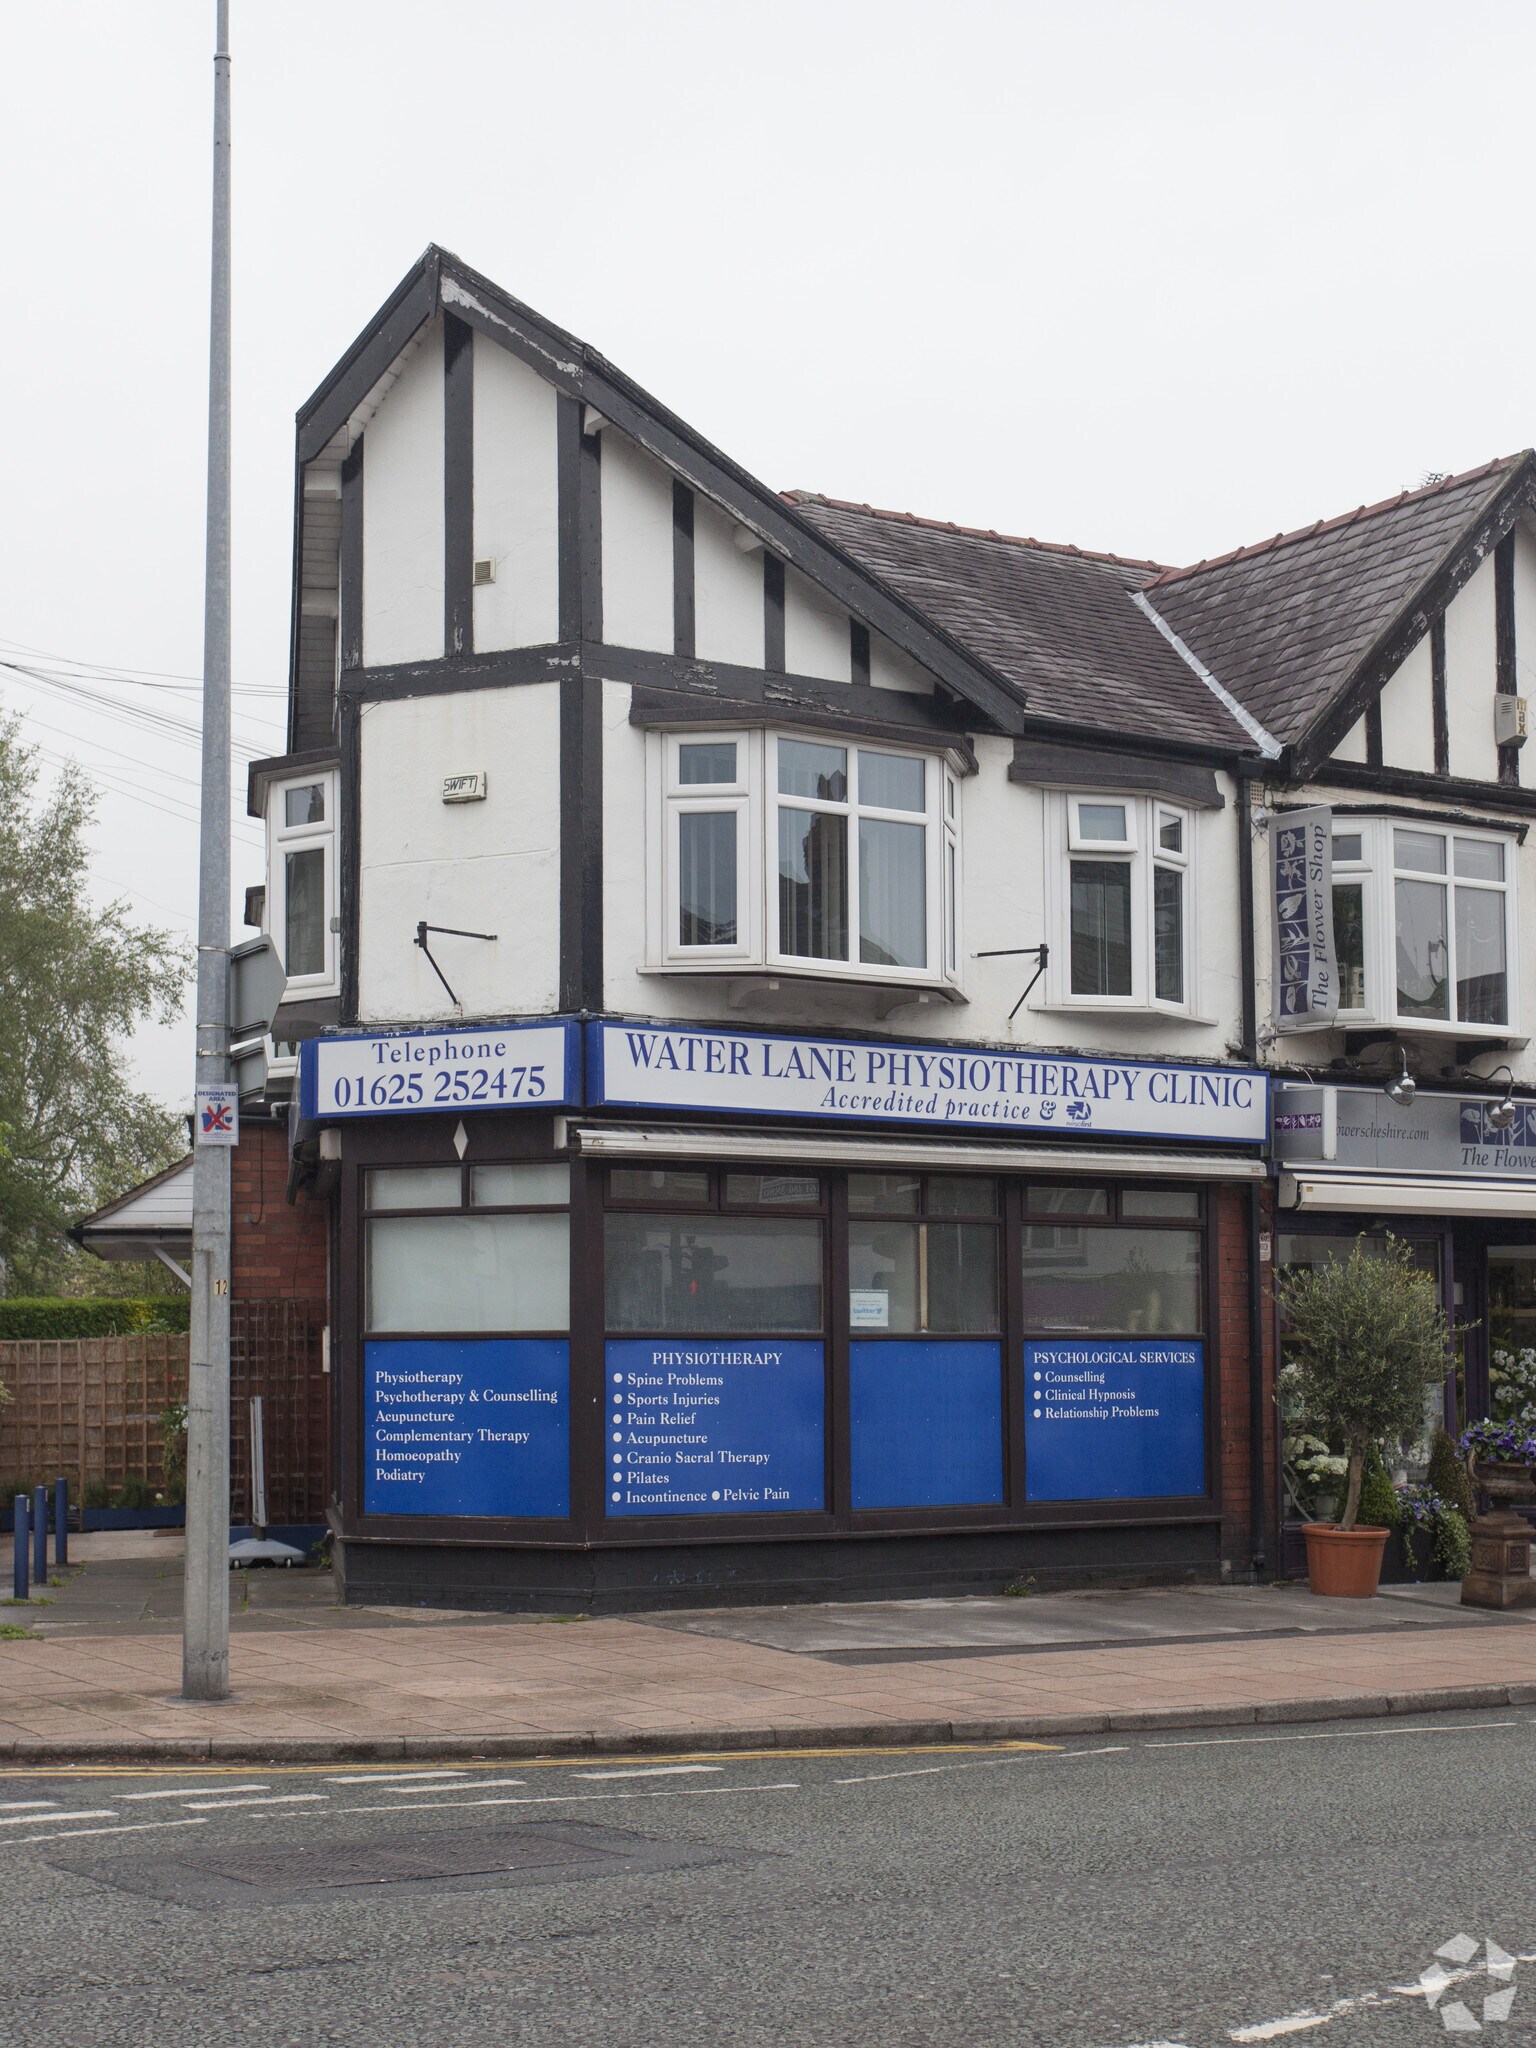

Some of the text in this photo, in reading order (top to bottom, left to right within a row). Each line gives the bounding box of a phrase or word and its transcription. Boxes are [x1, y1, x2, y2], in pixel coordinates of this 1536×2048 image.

[1309, 825, 1328, 1010] The Flower Shop
[372, 1041, 507, 1065] Telephone
[626, 1033, 1253, 1108] WATER LANE PHYSIOTHERAPY CLINIC
[335, 1066, 546, 1109] 01625 252475
[820, 1085, 1056, 1123] Accredited practice &
[1461, 1146, 1489, 1166] The
[215, 1279, 228, 1295] 12
[653, 1353, 782, 1364] PHYSIOTHERAPY
[1034, 1352, 1195, 1363] PSYCHOLOGICAL SERVICES
[376, 1371, 463, 1385] Physiotherapy
[628, 1373, 723, 1387] Spine Problems
[1045, 1371, 1105, 1384] Counselling
[376, 1389, 557, 1405] Psychotherapy & Counselling
[628, 1393, 719, 1407] Sports Injuries
[1045, 1389, 1135, 1402] Clinical Hypnosis
[376, 1410, 454, 1424] Acupuncture
[628, 1413, 696, 1424] Pain Relief
[1046, 1406, 1159, 1419] Relationship Problems
[376, 1429, 529, 1443] Complementary Therapy
[627, 1432, 707, 1446] Acupuncture
[376, 1449, 461, 1463] Homoeopathy
[627, 1451, 770, 1465] Cranio Sacral Therapy
[376, 1468, 425, 1483] Podiatry
[628, 1472, 669, 1483] Pilates
[627, 1488, 789, 1503] Incontinence Pelvic Pain
